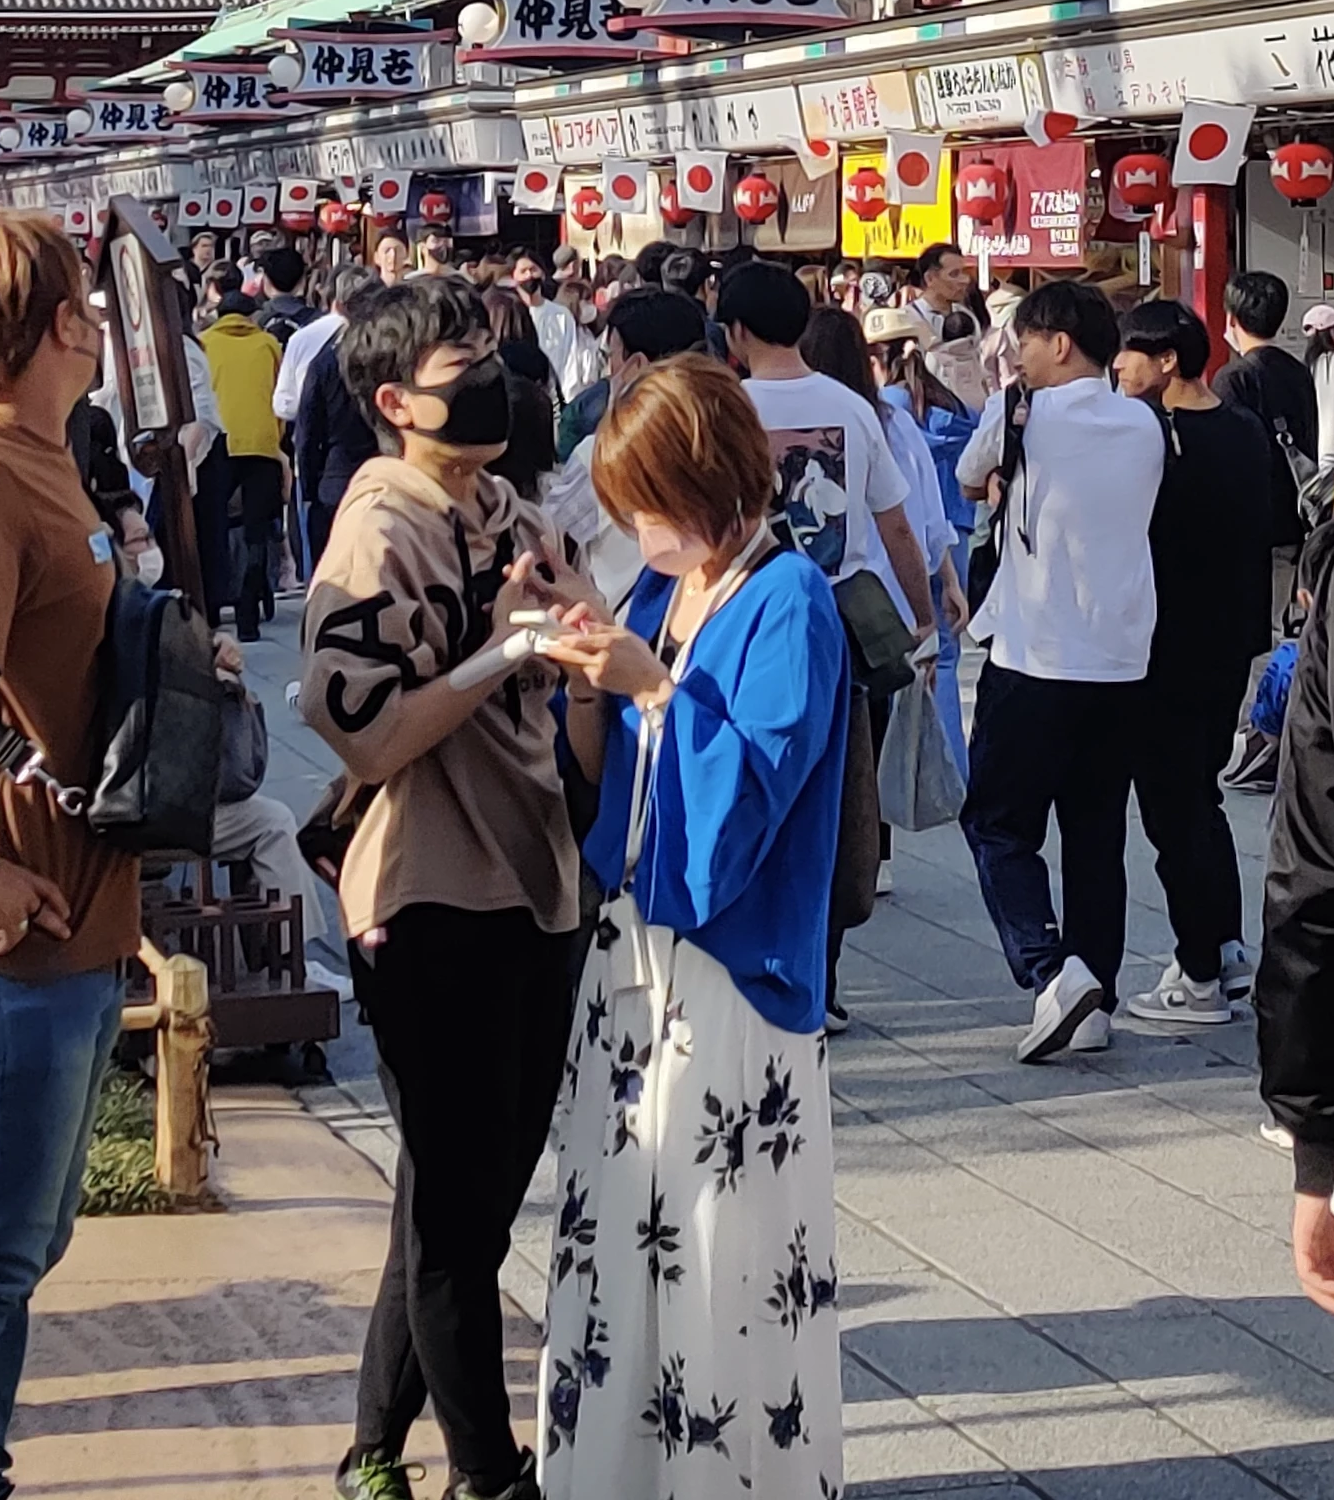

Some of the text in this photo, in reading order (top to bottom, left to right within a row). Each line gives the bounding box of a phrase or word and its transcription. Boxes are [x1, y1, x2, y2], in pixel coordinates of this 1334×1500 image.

[312, 45, 414, 85] 仲見世
[28, 122, 68, 147] 仲見
